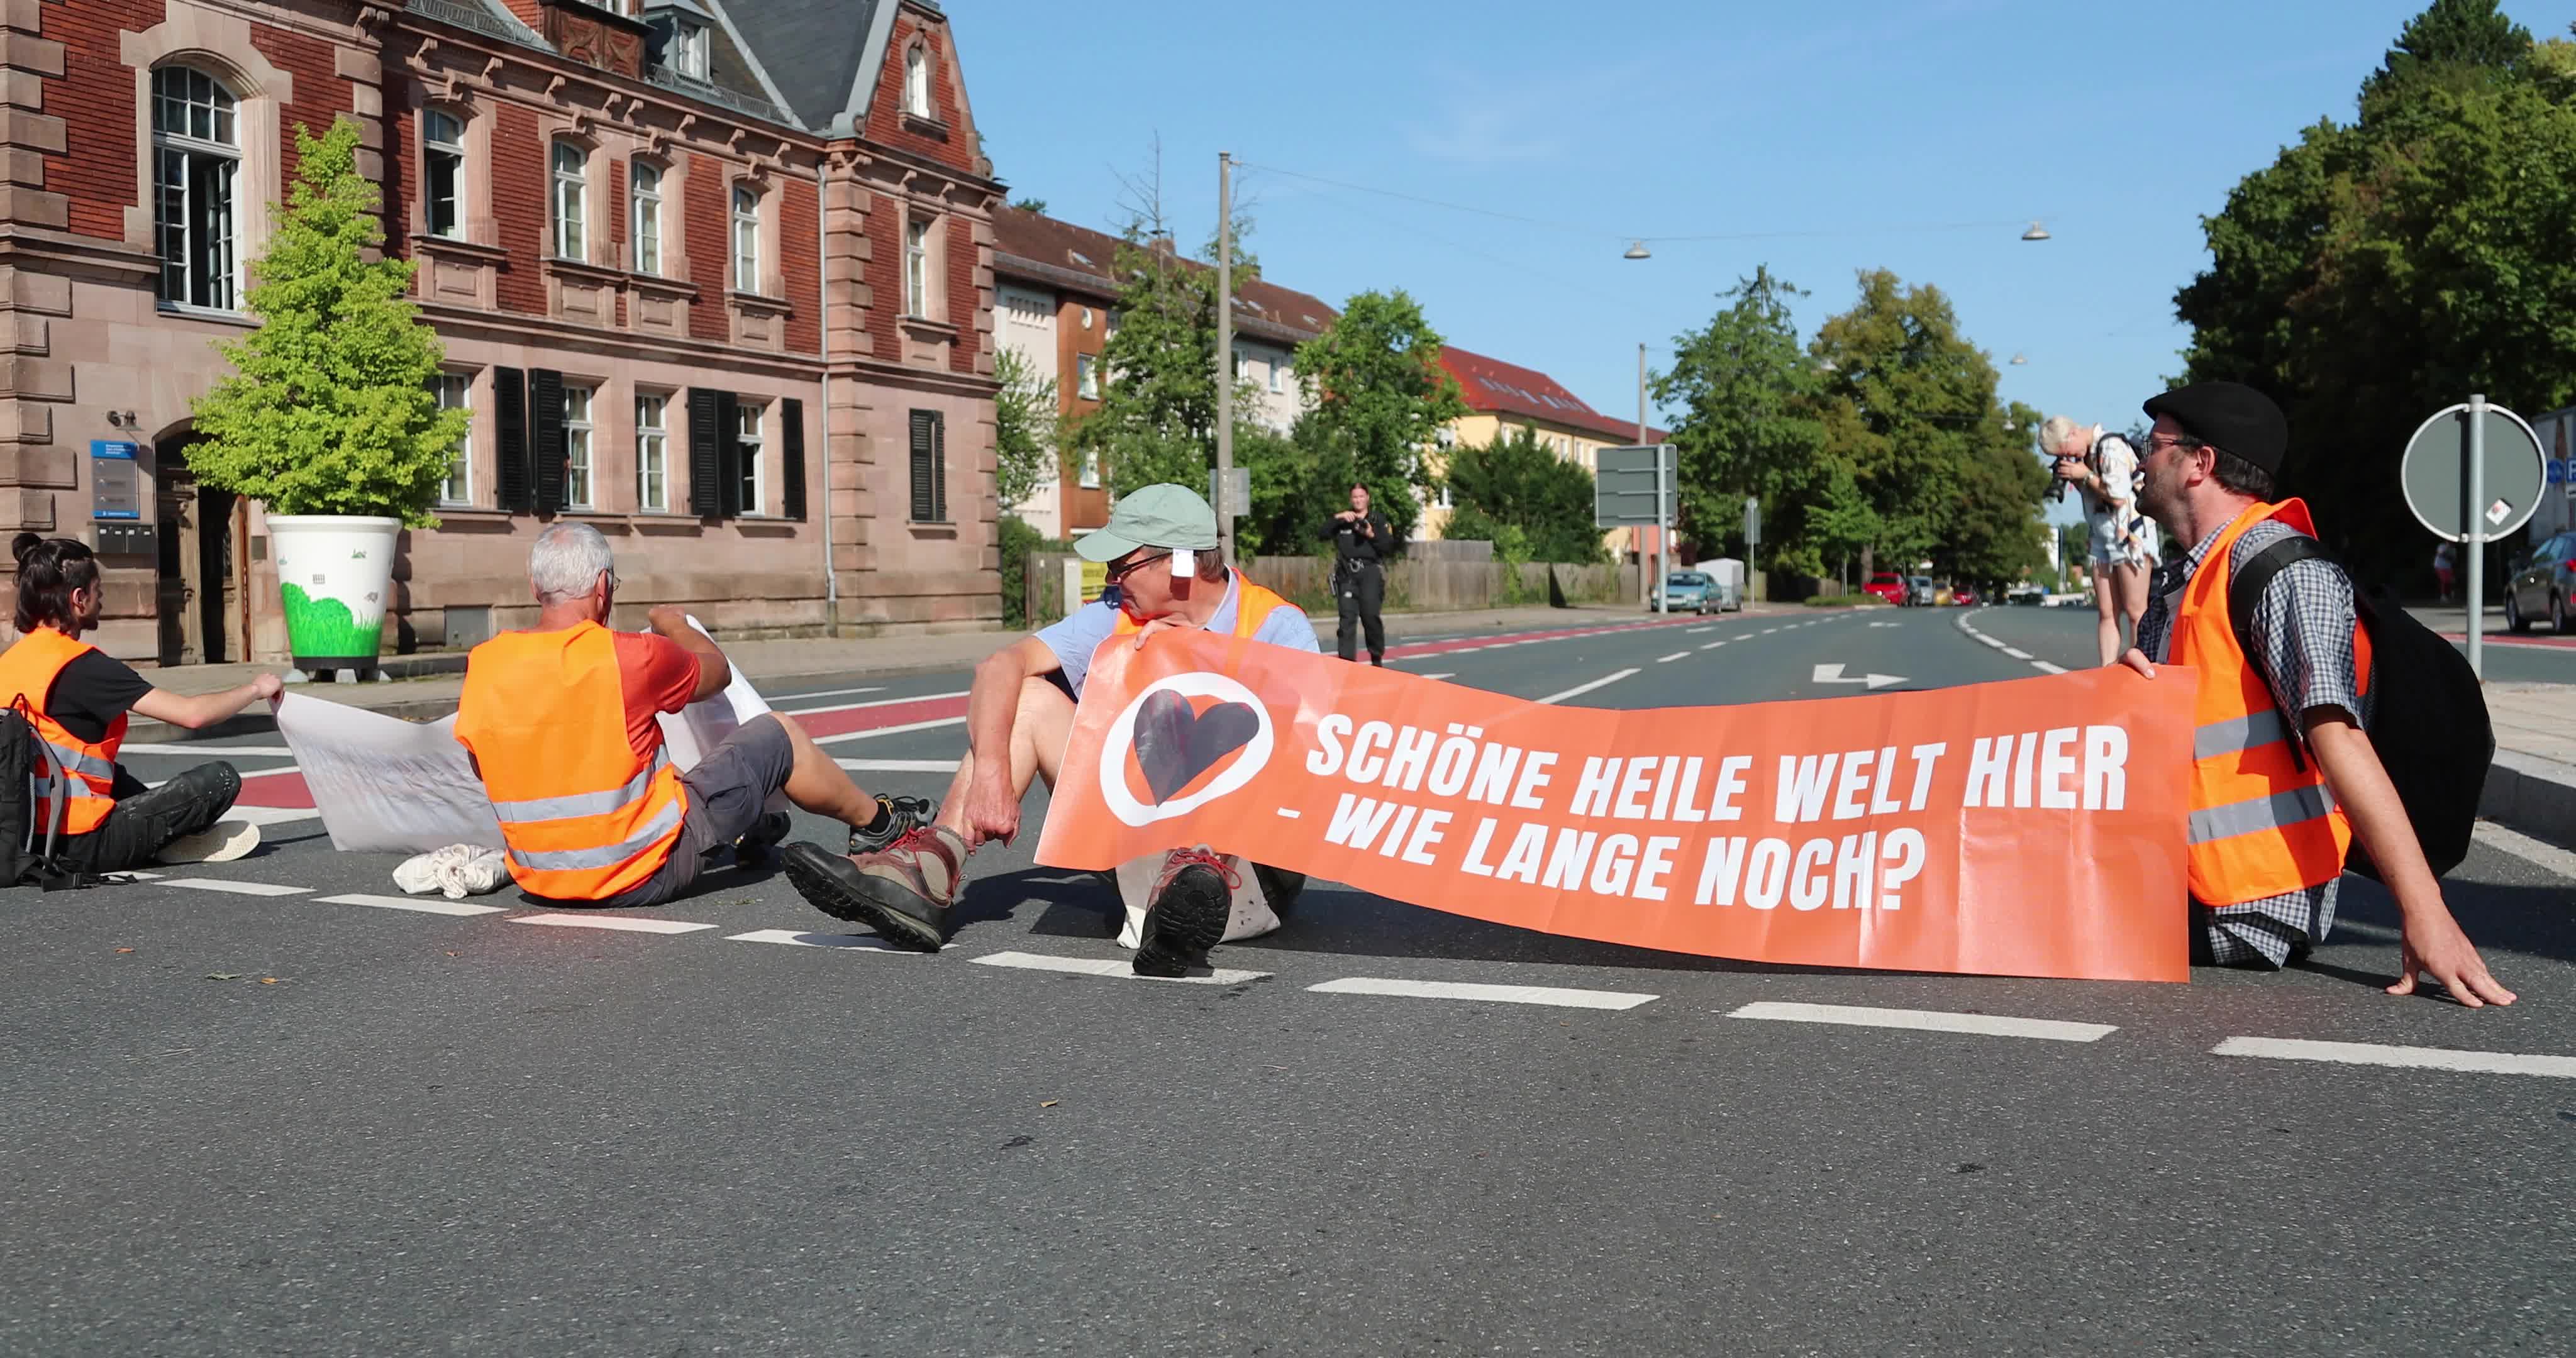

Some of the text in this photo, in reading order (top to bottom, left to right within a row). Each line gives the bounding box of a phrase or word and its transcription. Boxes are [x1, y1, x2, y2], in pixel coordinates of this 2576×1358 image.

[1306, 713, 2128, 824] SCHÖNE HEILE WELT HIER
[1324, 793, 1454, 866] WIE
[1460, 817, 1681, 901] LANGE
[1694, 827, 1926, 911] NOCH?
